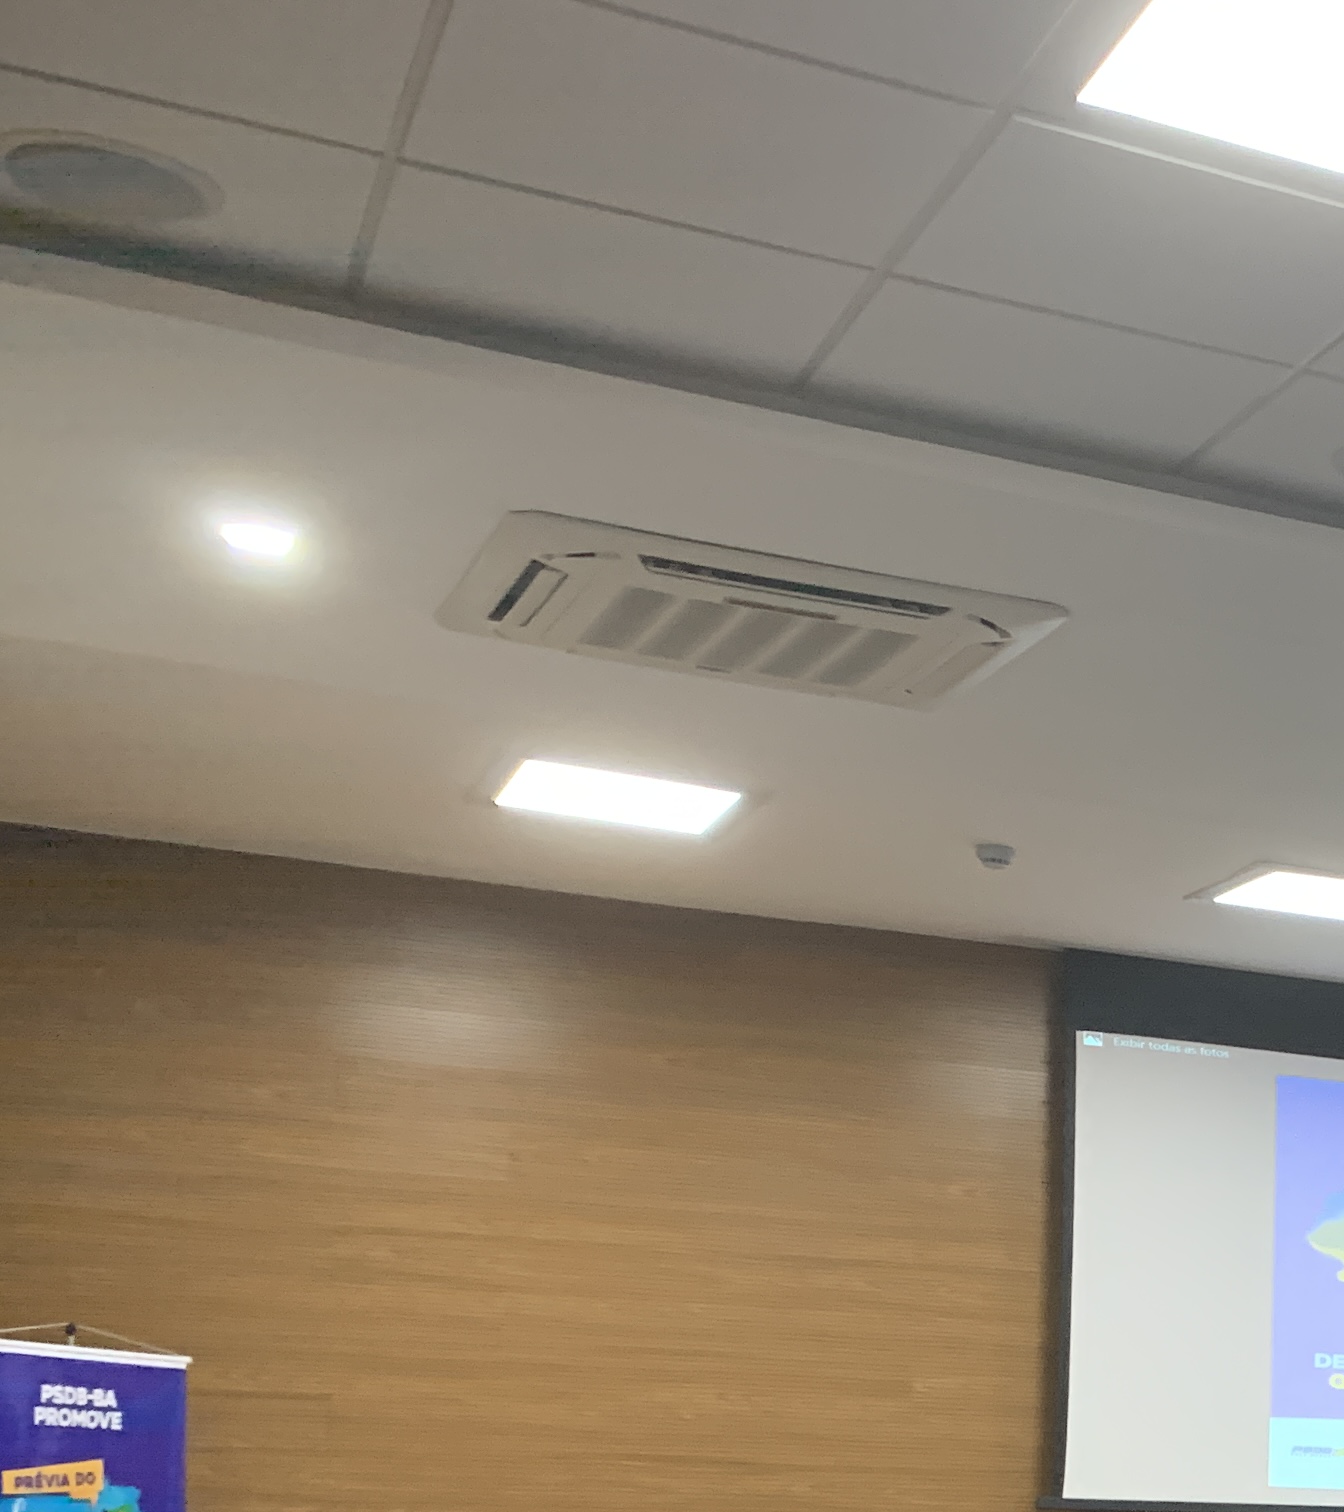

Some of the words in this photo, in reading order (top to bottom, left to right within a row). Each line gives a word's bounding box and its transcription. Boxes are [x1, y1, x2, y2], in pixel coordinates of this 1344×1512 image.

[1149, 1041, 1181, 1054] todas
[1185, 1046, 1198, 1055] as
[1200, 1047, 1230, 1059] fotos
[40, 1384, 118, 1409] PSDB-BA
[33, 1405, 123, 1431] PROMOVE
[14, 1471, 70, 1489] PRÉVIA
[75, 1471, 97, 1487] DO
